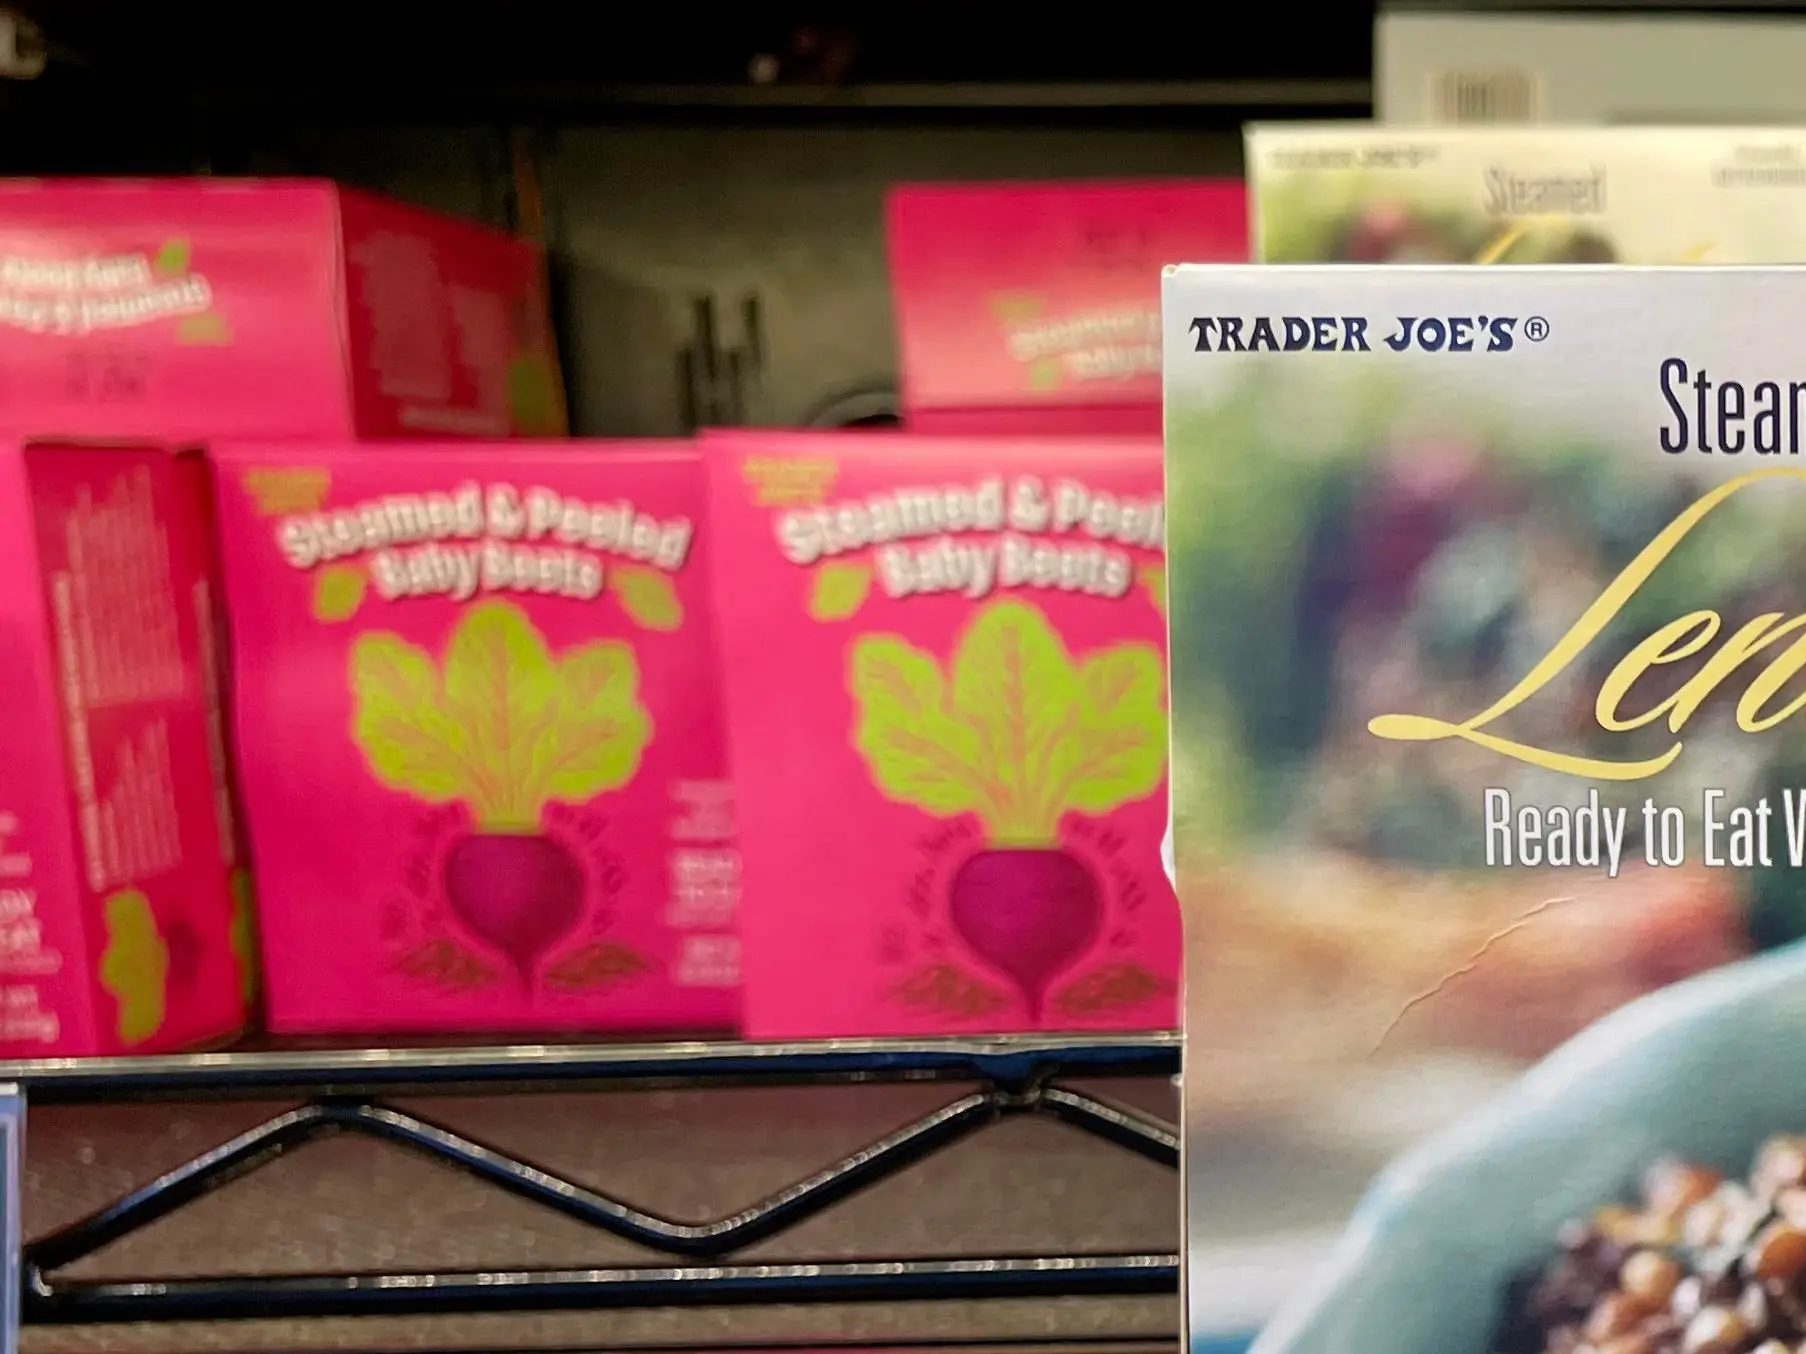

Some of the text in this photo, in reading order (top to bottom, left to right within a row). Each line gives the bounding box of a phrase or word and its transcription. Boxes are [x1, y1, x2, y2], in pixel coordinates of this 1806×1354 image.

[1188, 316, 1372, 352] TRADER
[1484, 788, 1626, 878] Ready
[1642, 797, 1685, 867] to
[1703, 788, 1773, 867] Eat
